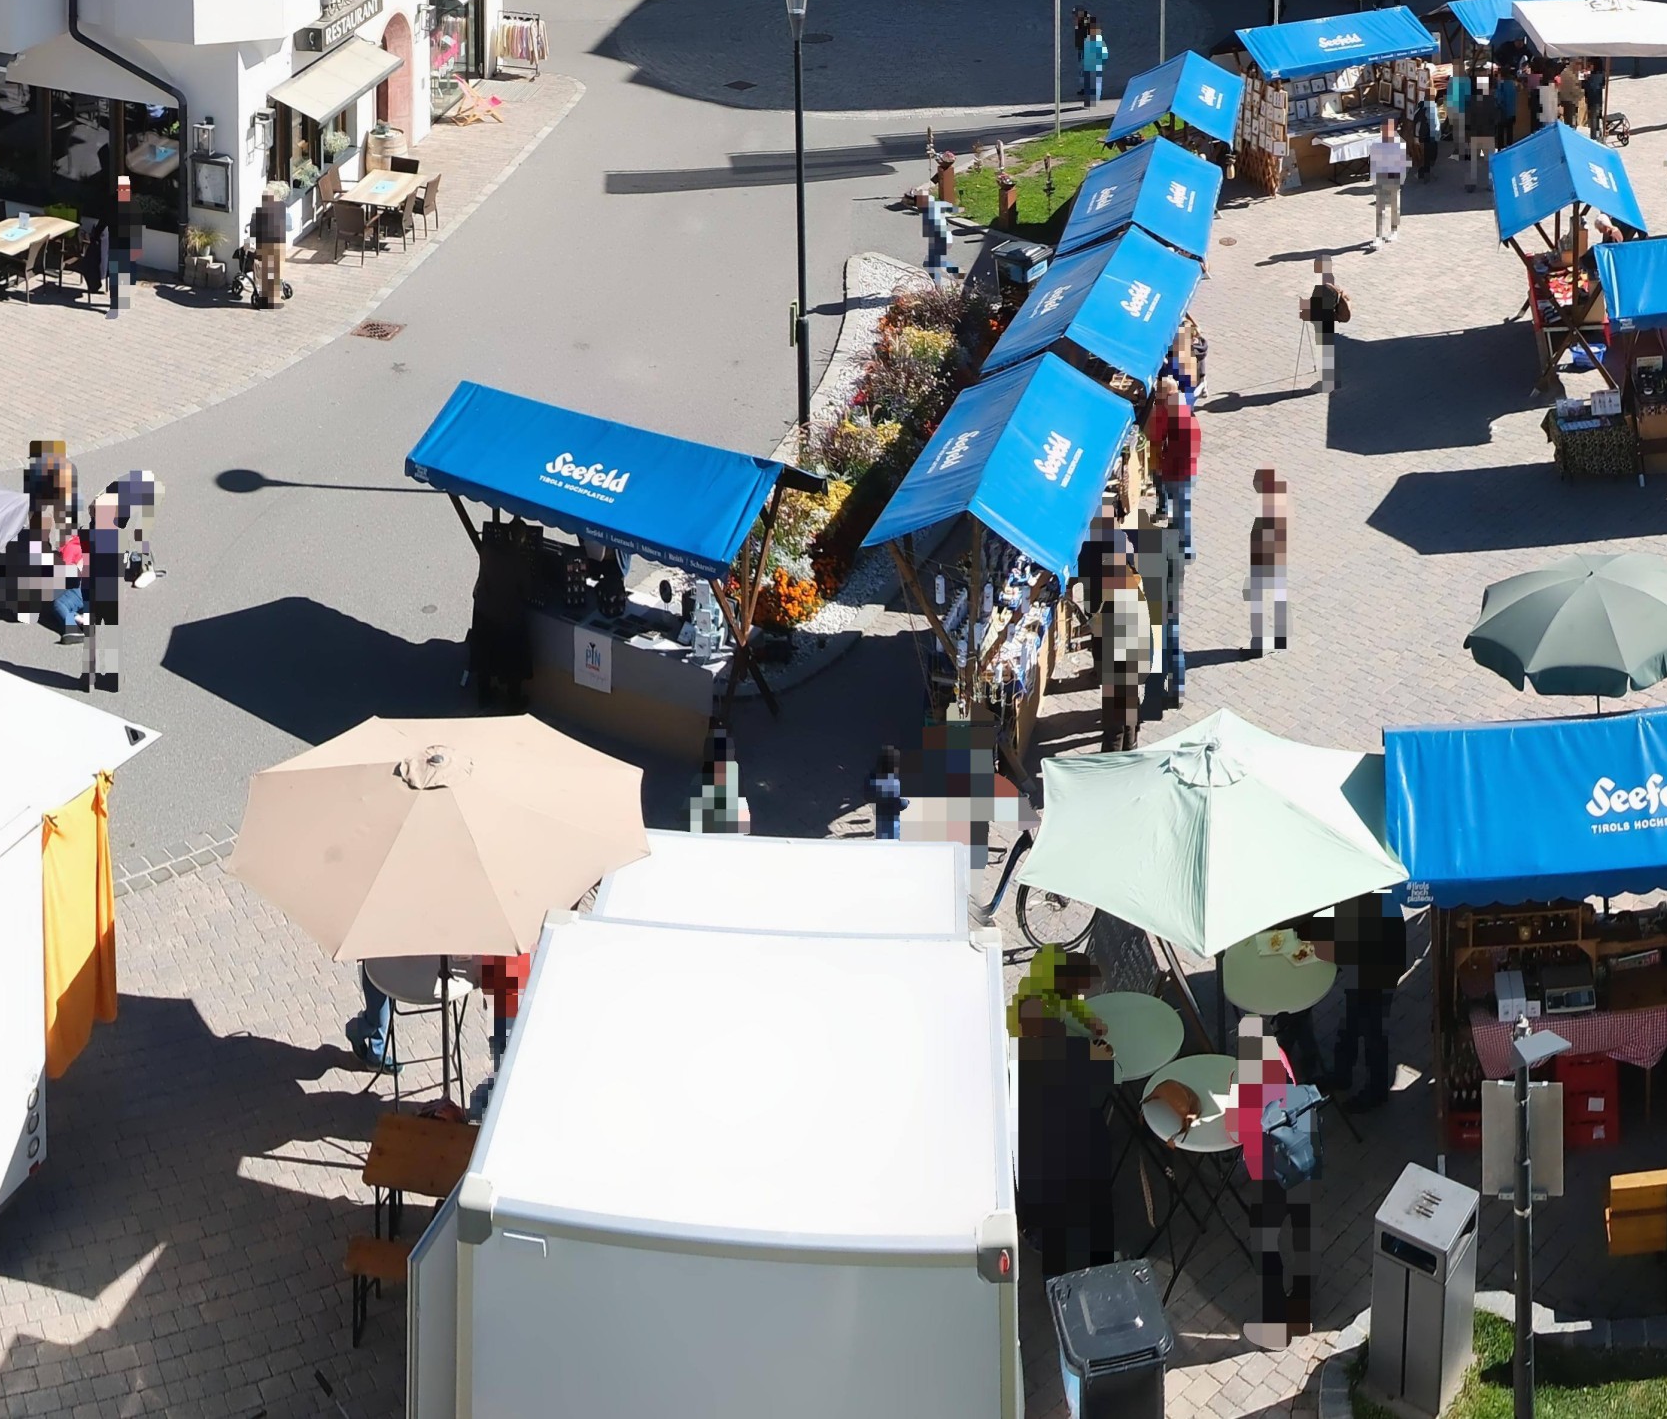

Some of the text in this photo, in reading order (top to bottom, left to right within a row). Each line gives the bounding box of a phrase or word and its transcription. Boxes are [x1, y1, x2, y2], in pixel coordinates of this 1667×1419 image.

[1318, 32, 1363, 49] Seefeld
[546, 452, 630, 493] Seefeld
[539, 475, 614, 504] TIROLS HOCHPLATEAU
[1591, 821, 1630, 834] TIROLS
